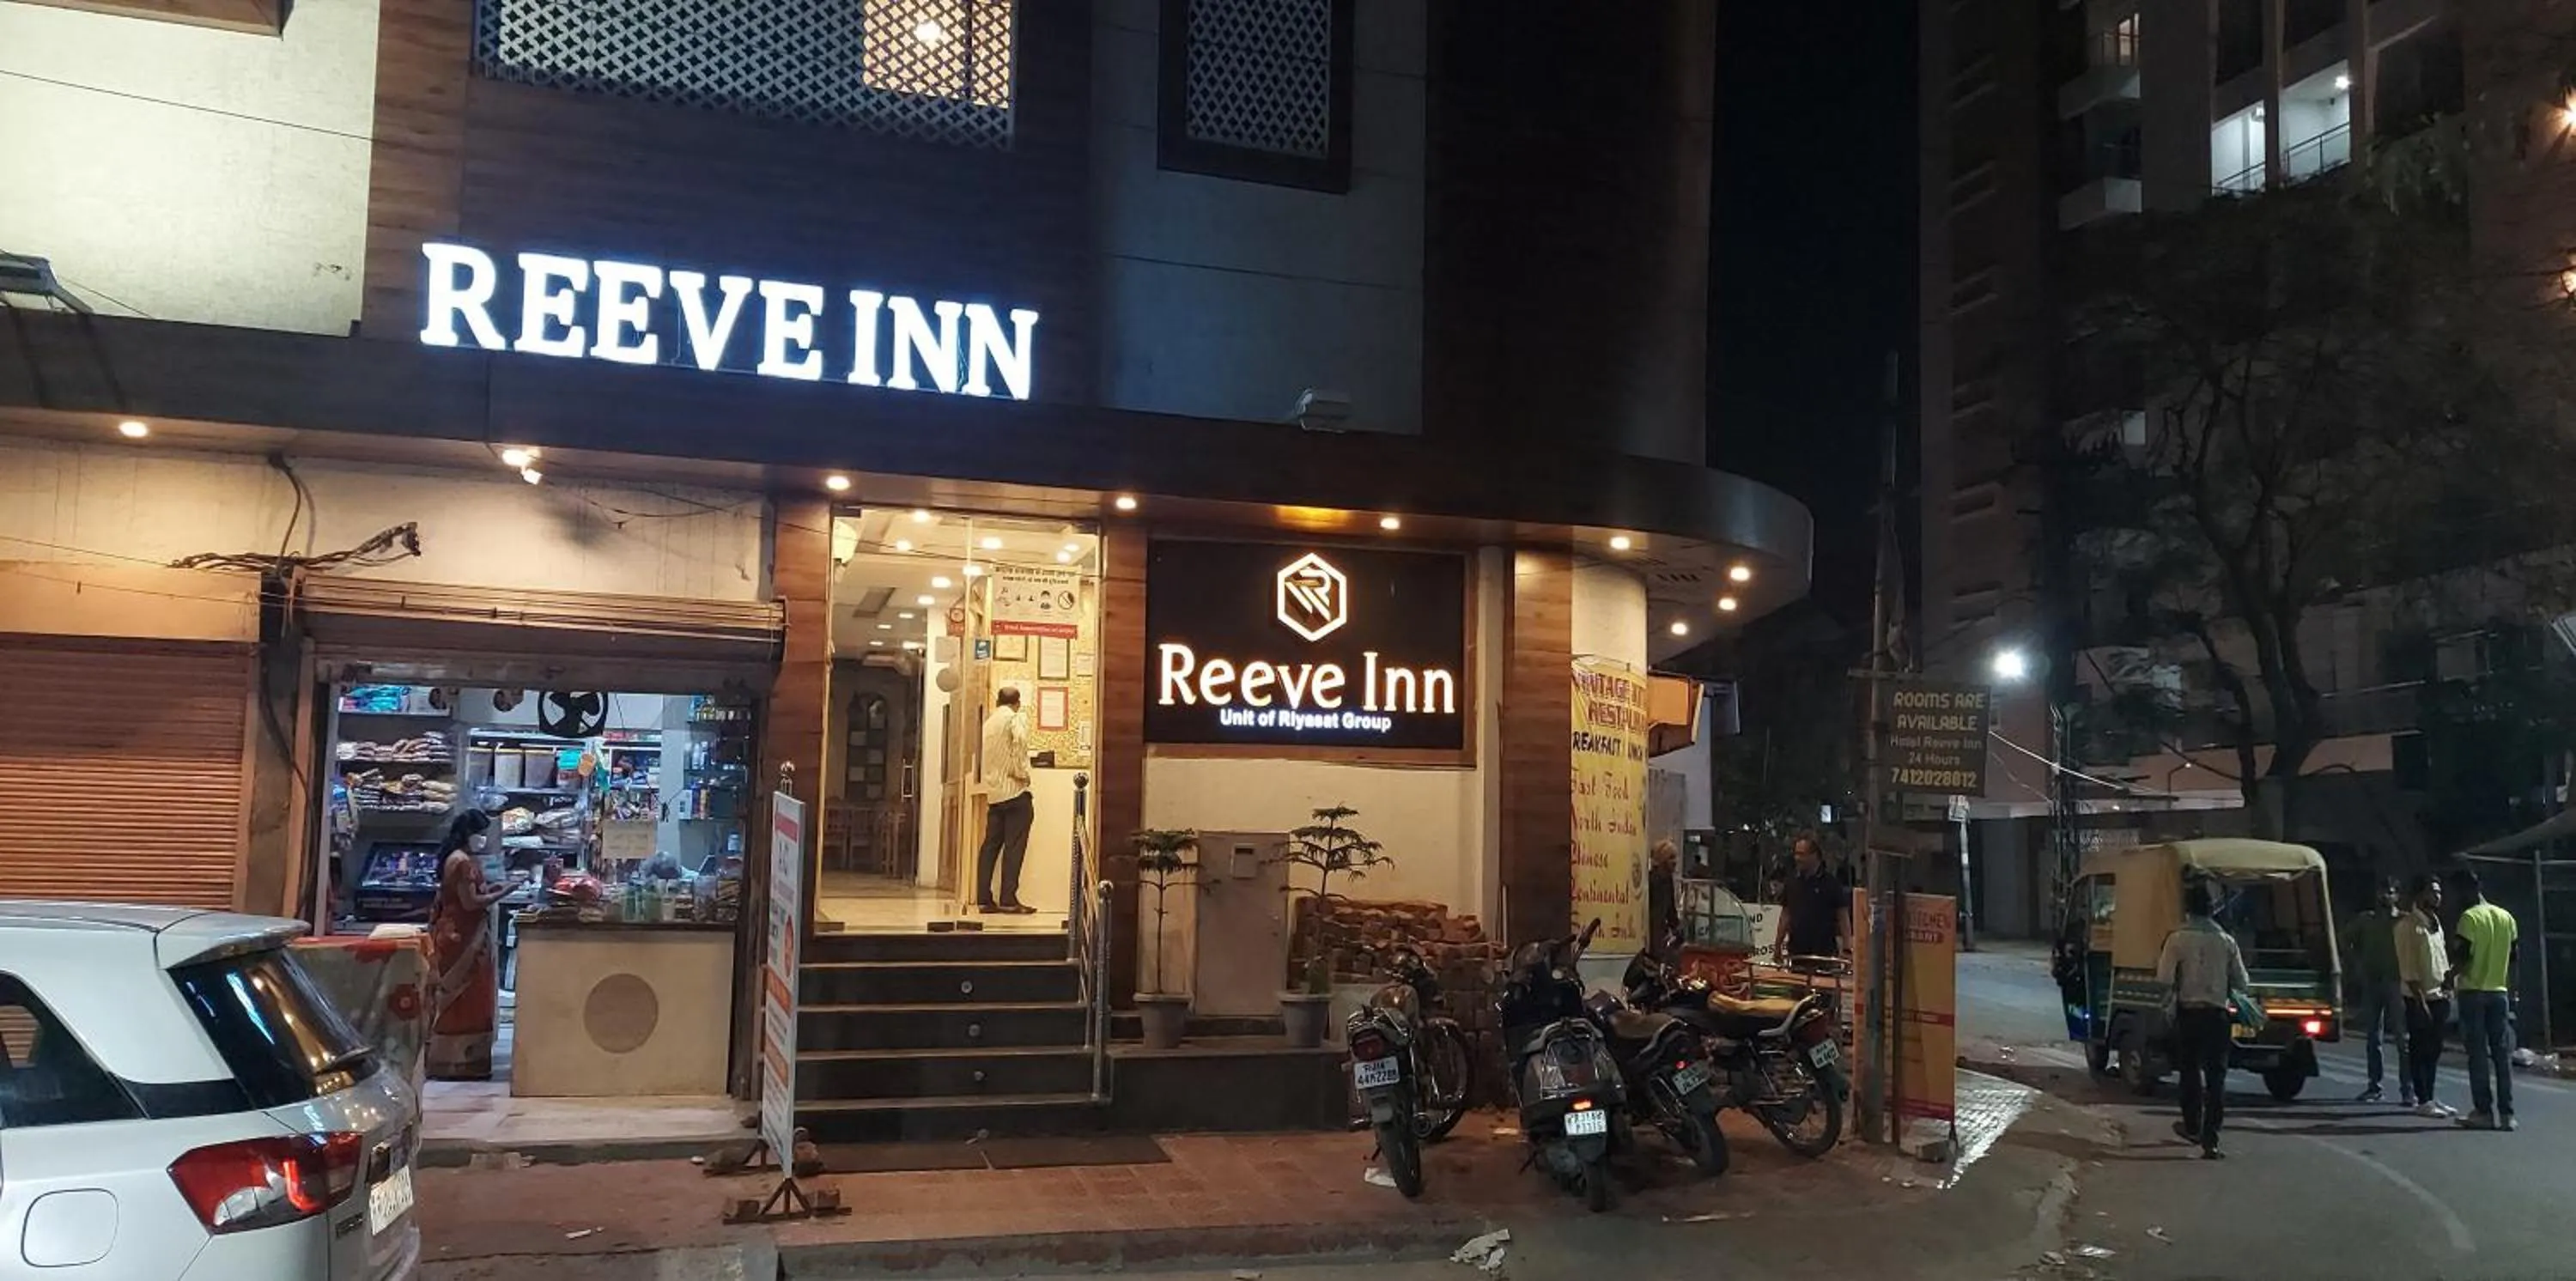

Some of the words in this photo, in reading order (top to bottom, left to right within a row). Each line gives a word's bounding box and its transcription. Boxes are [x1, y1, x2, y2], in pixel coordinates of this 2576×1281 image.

[420, 242, 824, 381] REEVE
[848, 289, 1039, 401] INN
[1157, 642, 1346, 710] Reeve
[1362, 651, 1455, 713] Inn
[1893, 691, 1950, 709] ROOMS
[1954, 692, 1985, 709] ARE
[1220, 708, 1255, 725] Unit
[1257, 710, 1276, 726] of
[1342, 712, 1392, 732] Group
[1897, 713, 1978, 732] AVAILABLE
[1924, 752, 1960, 766] Hours
